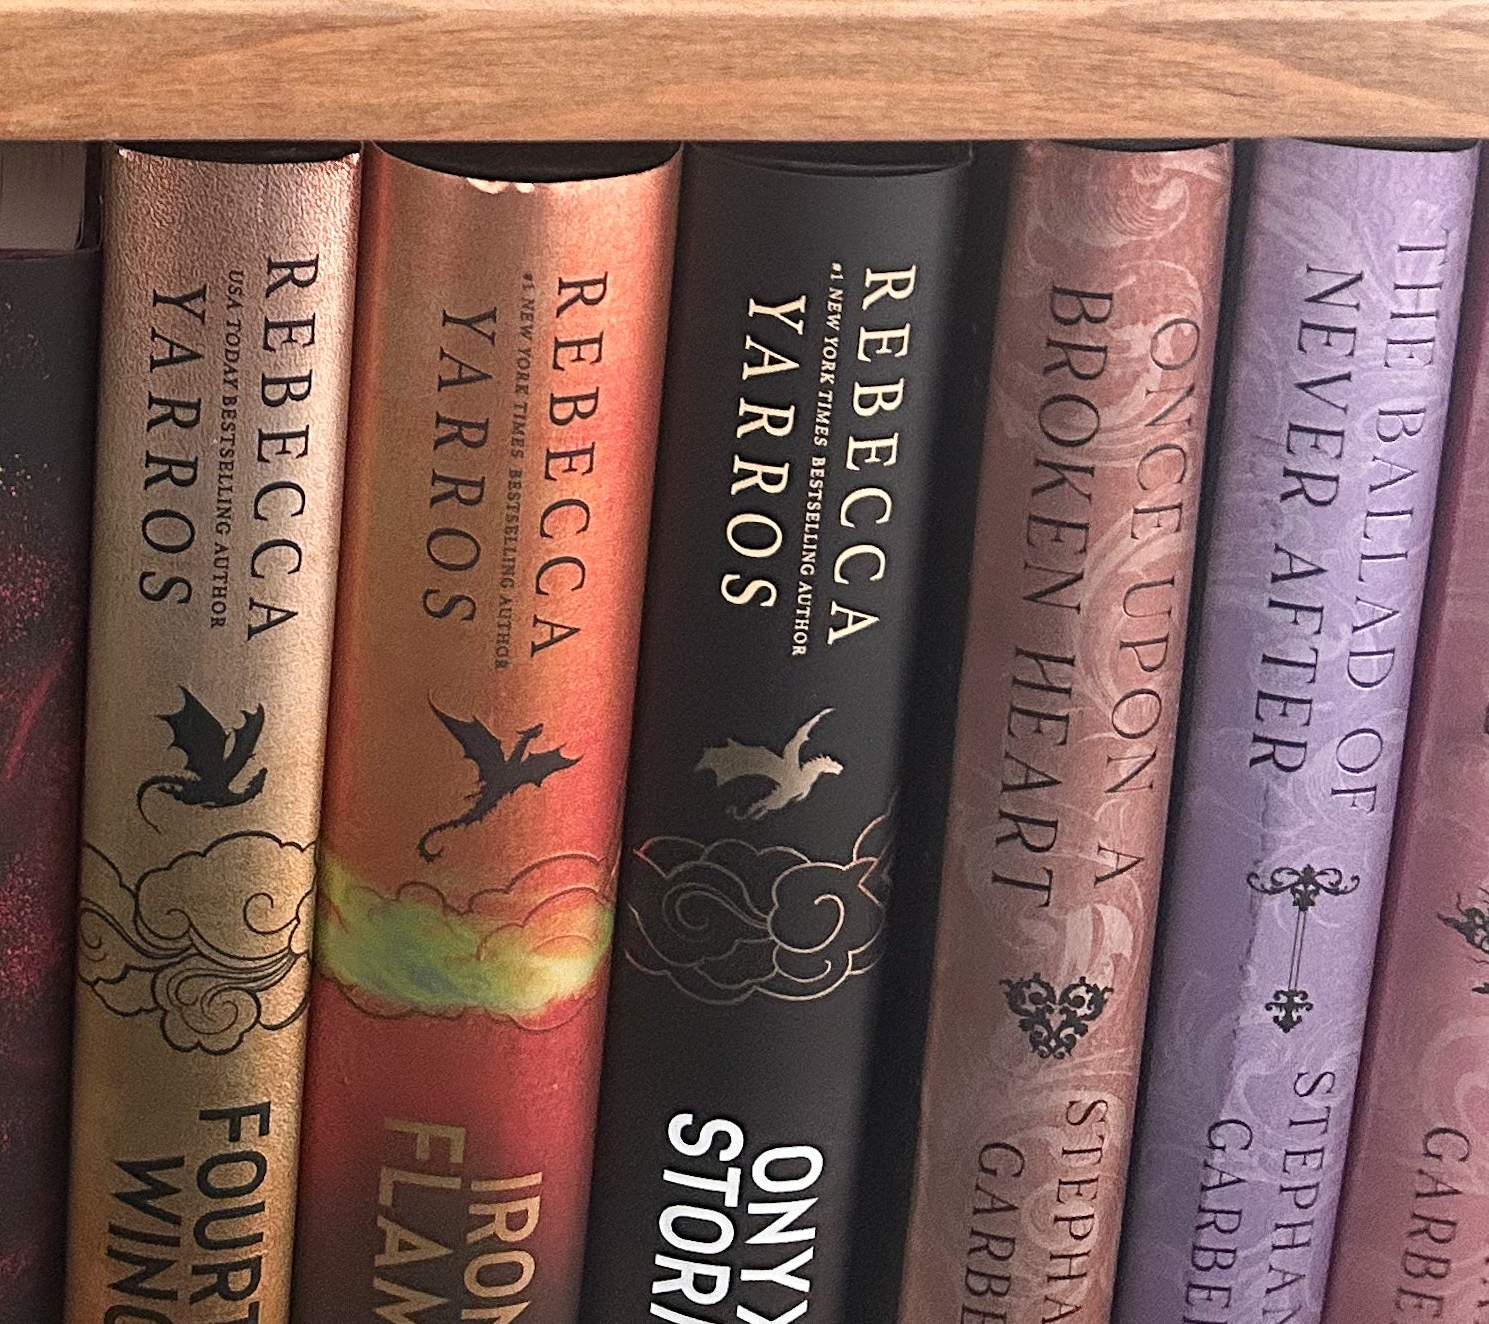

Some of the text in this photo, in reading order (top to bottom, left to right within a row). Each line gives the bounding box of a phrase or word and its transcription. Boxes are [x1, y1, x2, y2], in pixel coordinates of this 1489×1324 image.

[139, 283, 207, 606] YARROS
[210, 268, 245, 630] USA TODAY BESTSELLING AUTHOR
[247, 253, 320, 642] REBECCA
[422, 306, 498, 624] YARROS
[495, 299, 535, 671] NEW YORK TIMES BESTSELLING AUTHOR
[530, 271, 609, 658] REBECCA
[720, 294, 808, 609] YARROS
[813, 389, 833, 447] TIMES
[820, 336, 838, 385] YORK
[826, 264, 917, 646] REBECCA
[827, 286, 844, 332] NEW
[792, 581, 813, 656] AUTHOR
[798, 456, 825, 577] BESTSELLING
[990, 285, 1114, 908] BROKEN HEART
[1093, 318, 1201, 889] ONCE UPON A
[1248, 263, 1364, 775] NEVER AFTER
[1331, 229, 1449, 814] THE BALLAD OF
